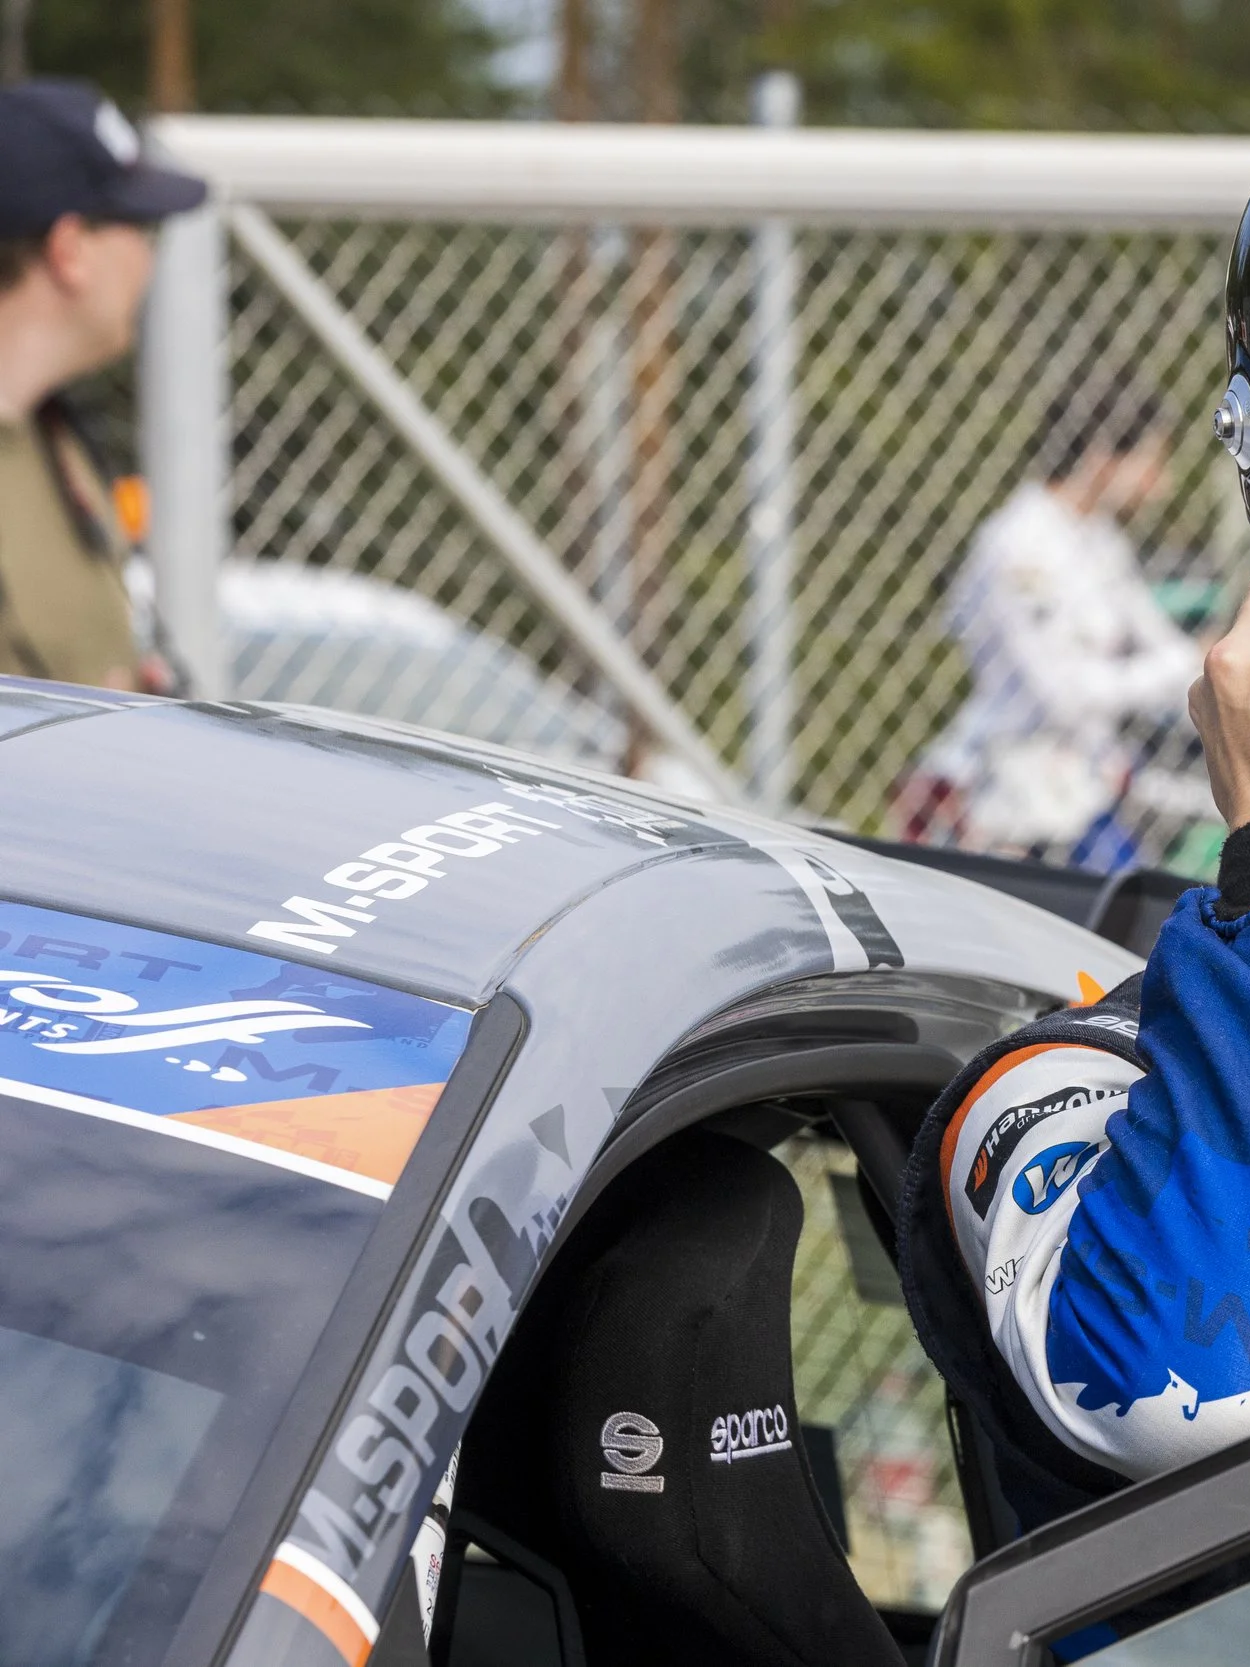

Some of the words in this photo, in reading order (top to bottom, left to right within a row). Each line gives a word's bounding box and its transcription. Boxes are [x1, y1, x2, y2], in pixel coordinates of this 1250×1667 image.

[246, 801, 562, 954] M-SPORT
[284, 1262, 520, 1580] M-SPOR
[710, 1404, 789, 1464] sparco
